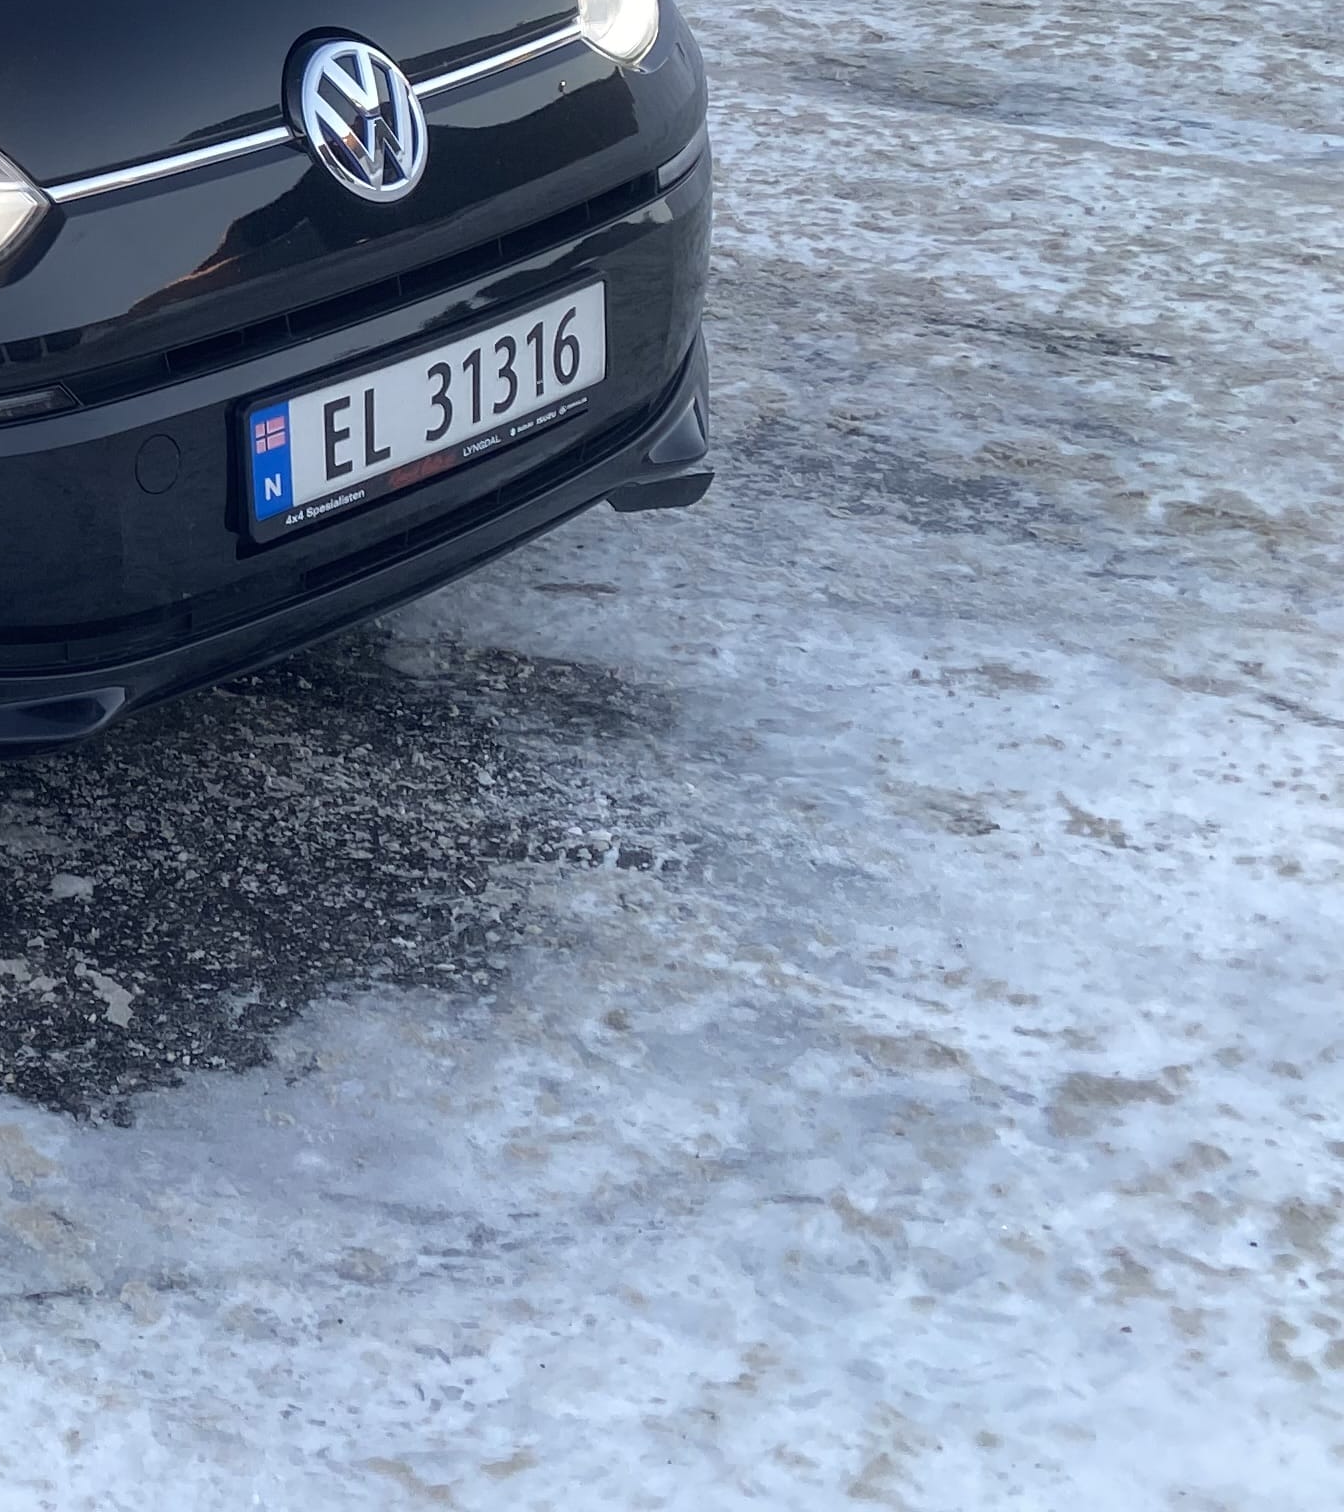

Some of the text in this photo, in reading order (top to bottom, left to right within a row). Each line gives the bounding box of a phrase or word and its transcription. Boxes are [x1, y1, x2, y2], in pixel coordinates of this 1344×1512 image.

[323, 306, 580, 481] EL 31316
[462, 433, 502, 457] LYNGDAL
[265, 473, 282, 501] N
[285, 489, 366, 526] 4x4 Spesialisten
